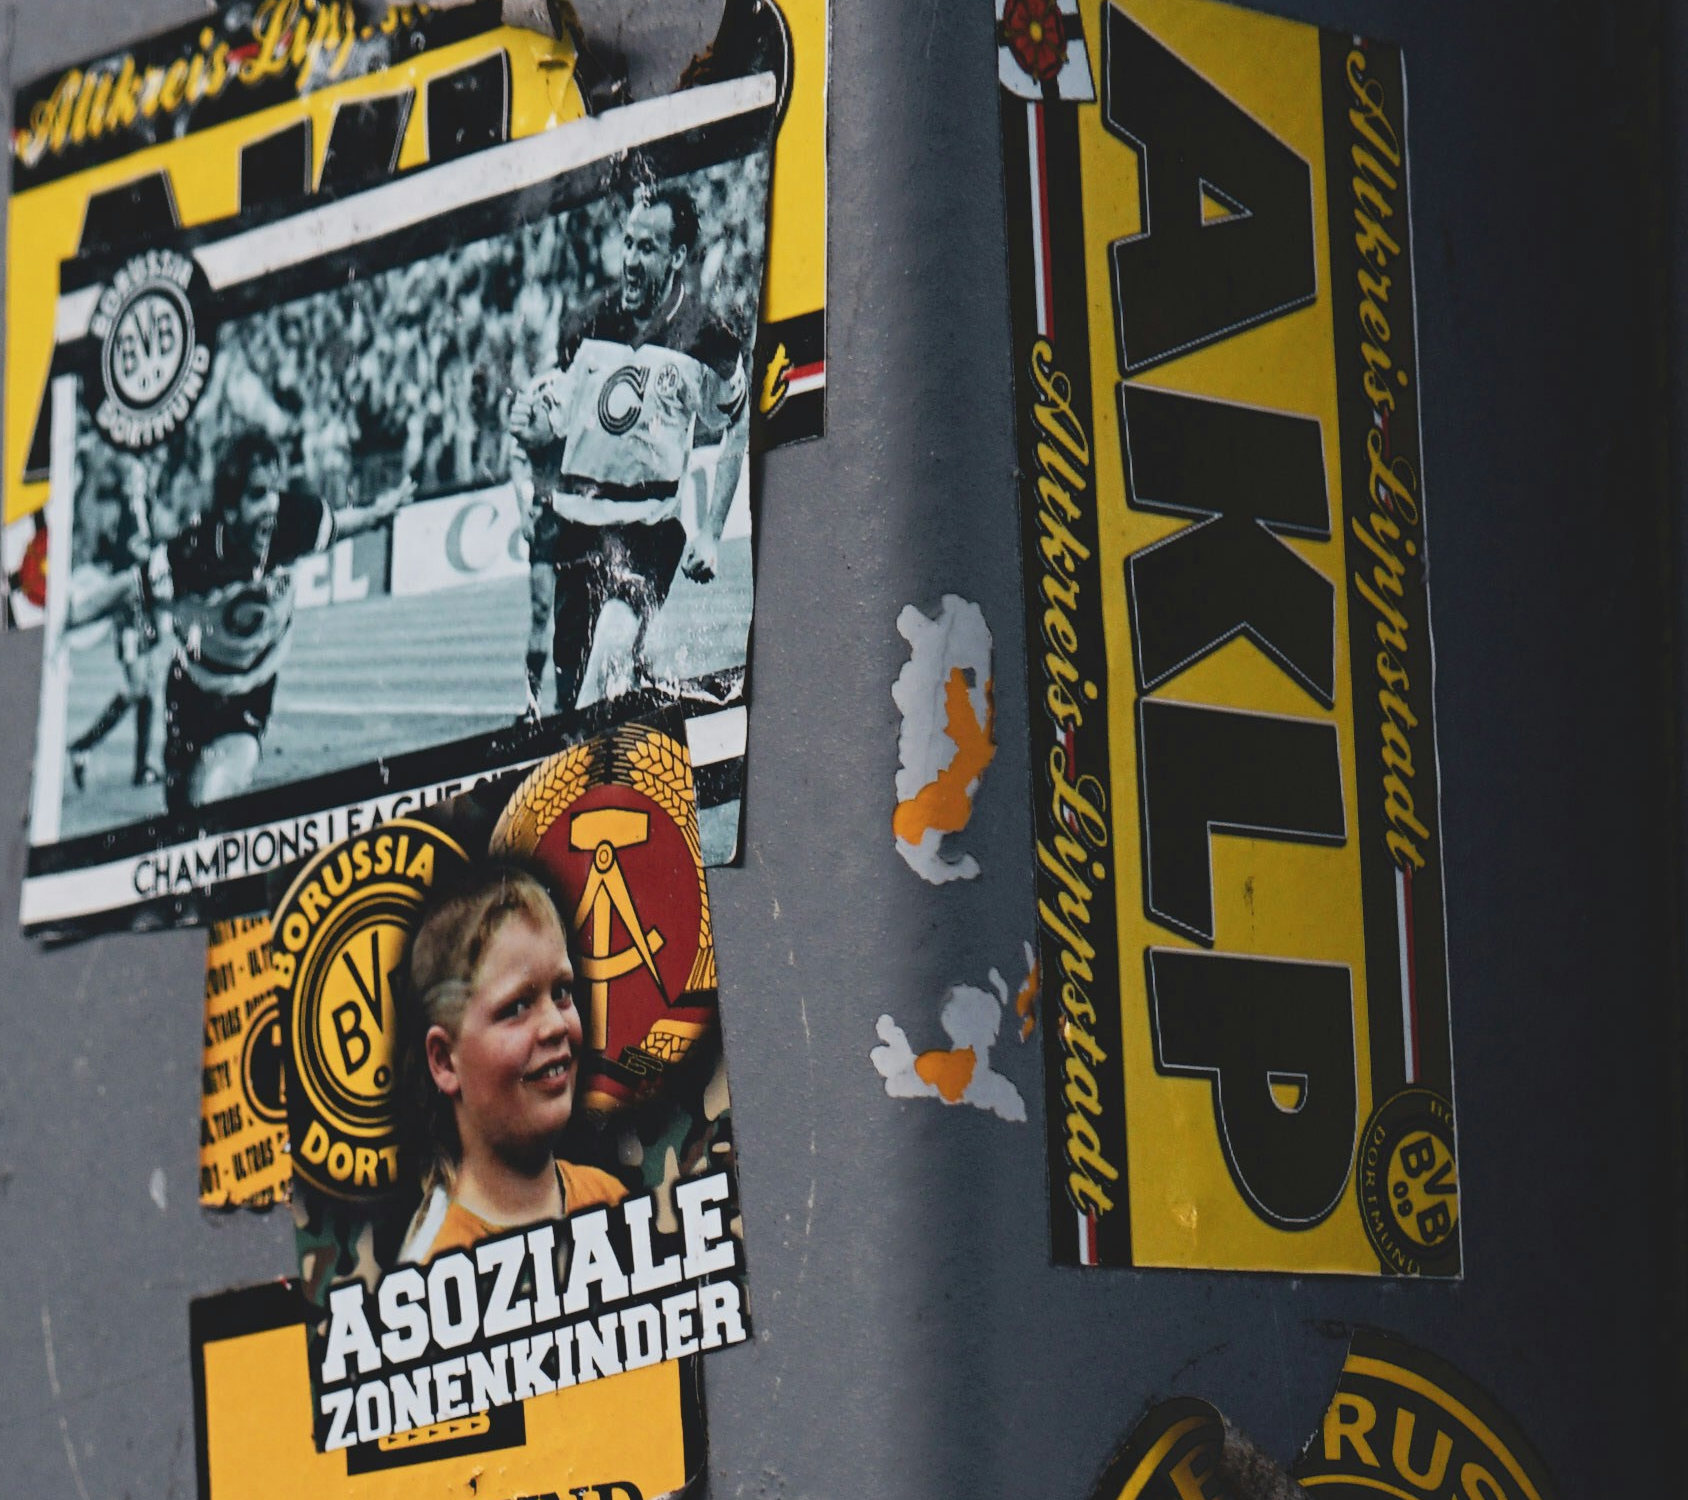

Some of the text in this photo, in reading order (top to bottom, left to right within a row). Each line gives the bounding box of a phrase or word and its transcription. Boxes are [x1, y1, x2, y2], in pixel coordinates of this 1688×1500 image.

[1346, 46, 1430, 872] Altkreis Lippstadt
[1102, 0, 1358, 1230] AKLP
[133, 817, 318, 897] CHAMPIONS
[1034, 340, 1118, 1215] Altkreis Lippstadt
[272, 835, 435, 990] BORUSSIA
[332, 930, 388, 1076] BV
[300, 1119, 399, 1189] DORT
[323, 1173, 735, 1383] ASOZIALE
[323, 1285, 747, 1453] ZONENKINDER
